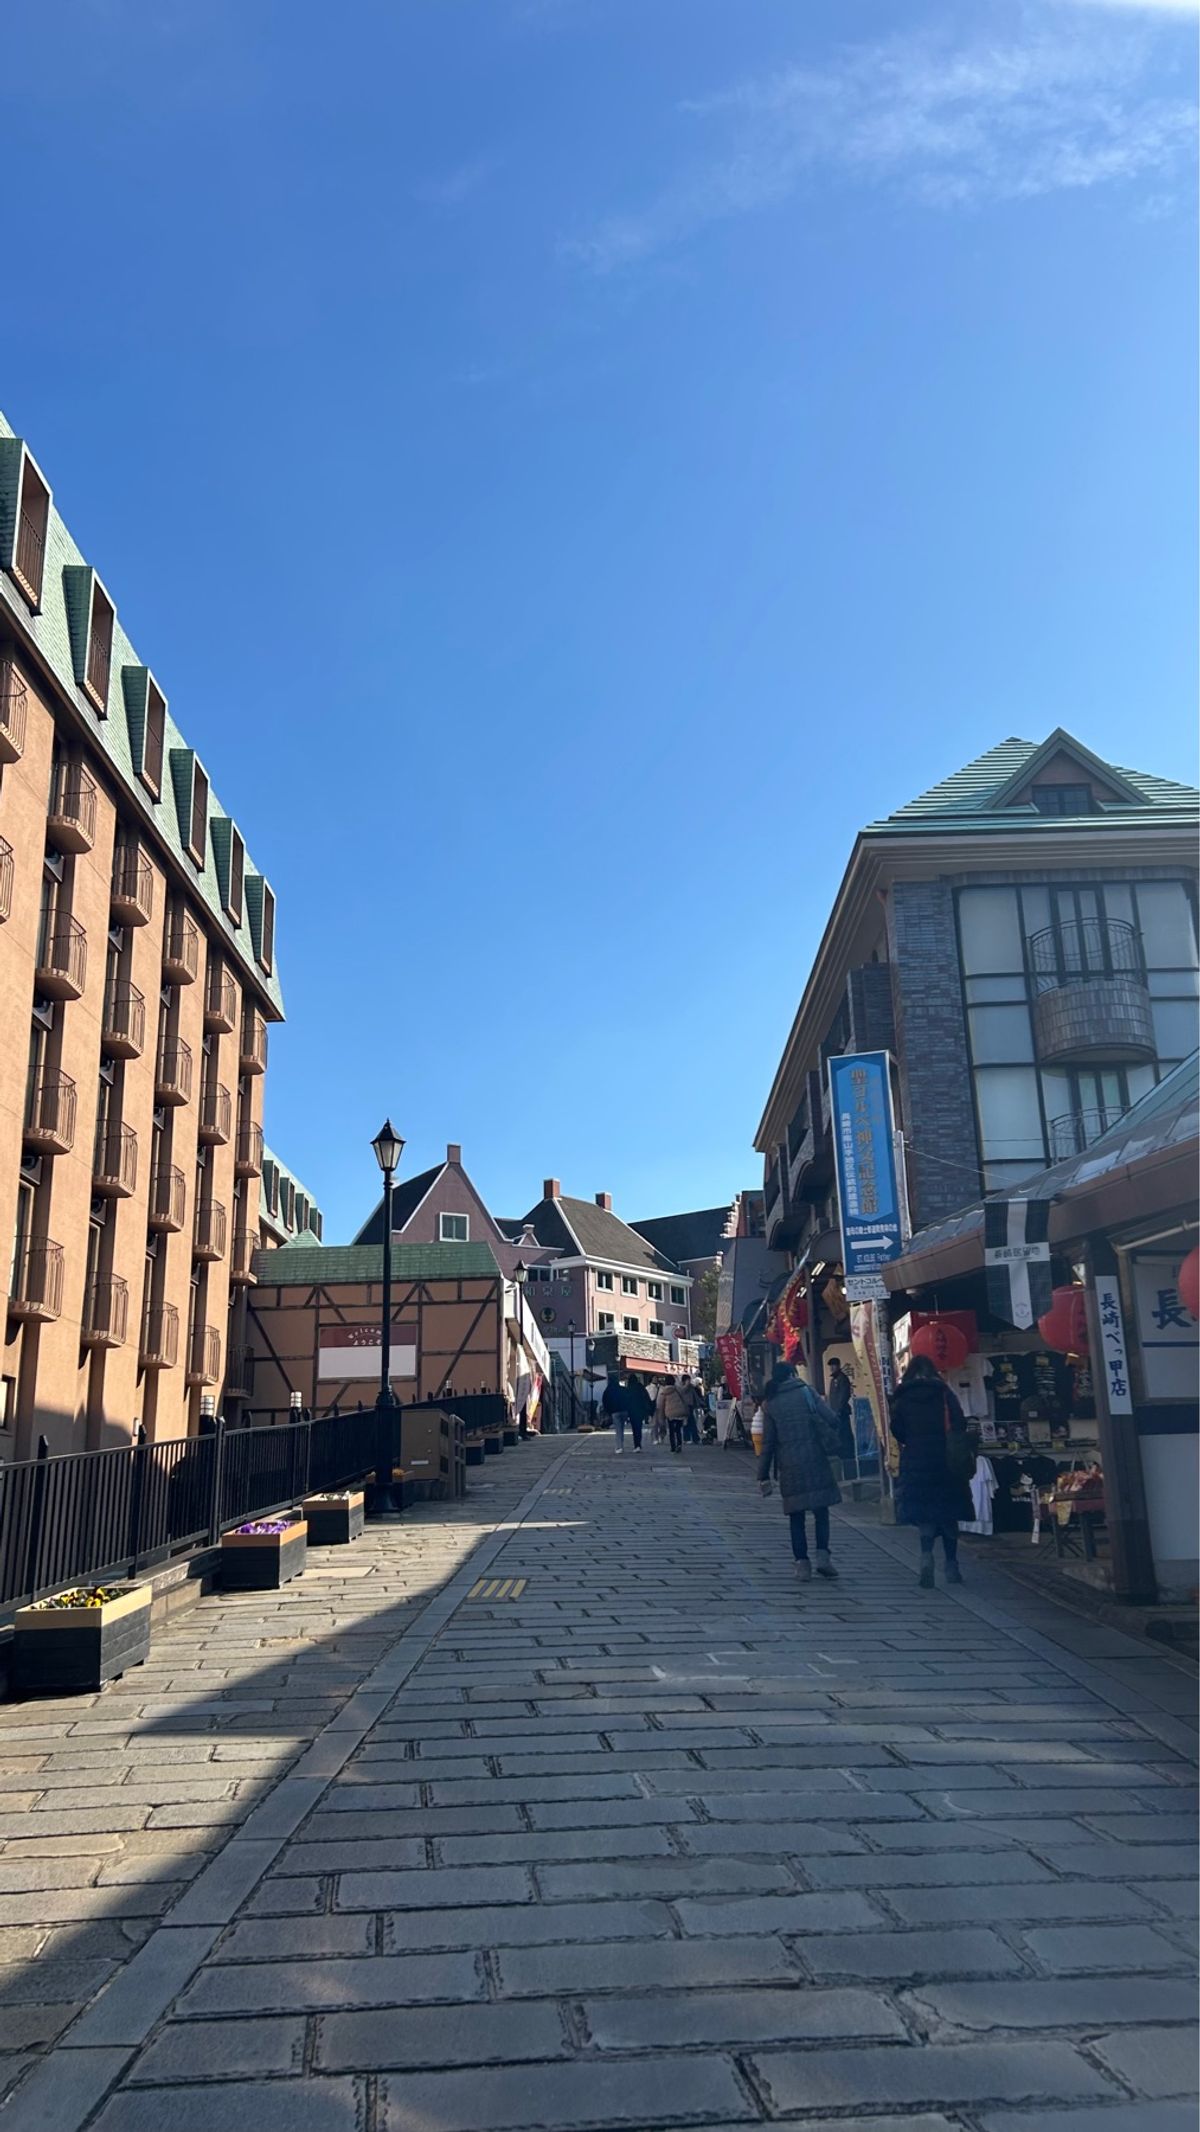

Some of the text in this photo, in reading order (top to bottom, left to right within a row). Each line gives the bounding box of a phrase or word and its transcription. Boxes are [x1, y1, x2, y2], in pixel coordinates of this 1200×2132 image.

[1100, 1293, 1128, 1397] 長崎べっ甲店
